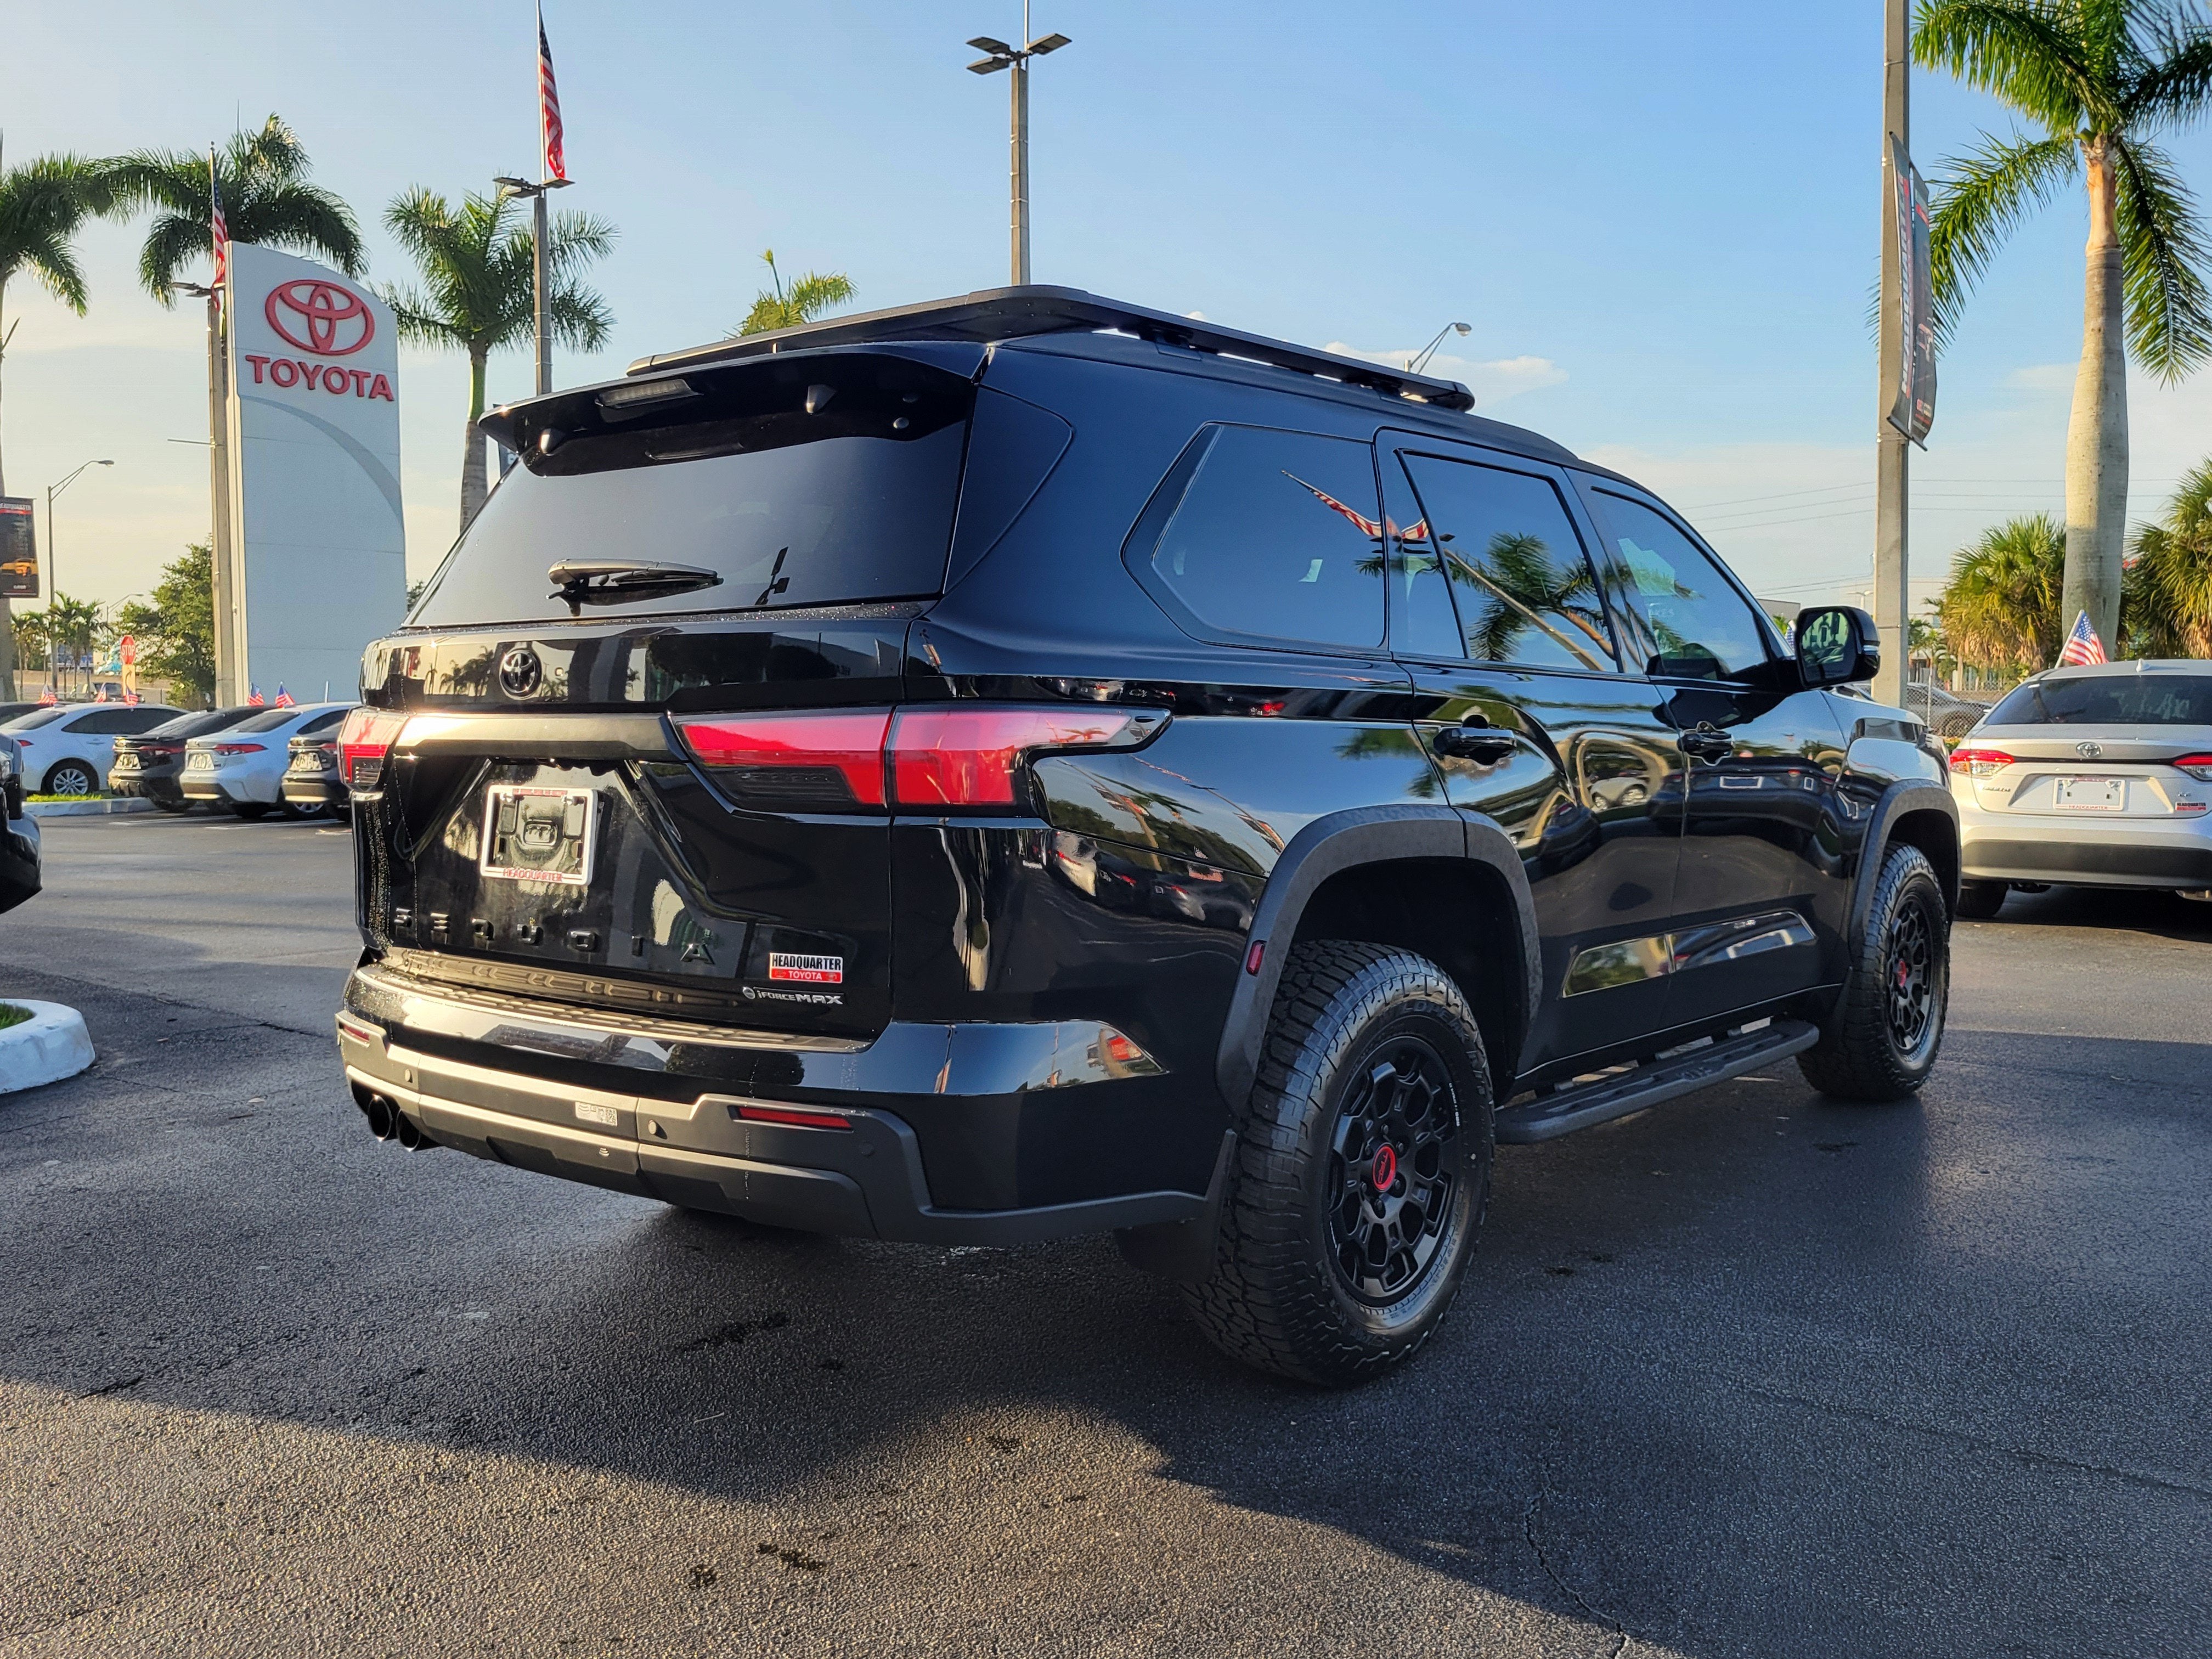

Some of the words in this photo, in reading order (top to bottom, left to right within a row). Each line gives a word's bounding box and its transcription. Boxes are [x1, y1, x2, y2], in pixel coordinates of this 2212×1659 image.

[245, 355, 395, 402] TOYOTA
[121, 645, 136, 657] STOP
[503, 868, 563, 882] HEADQUARTER
[771, 954, 841, 970] HEADQUARTER
[788, 970, 822, 980] TOYOTA
